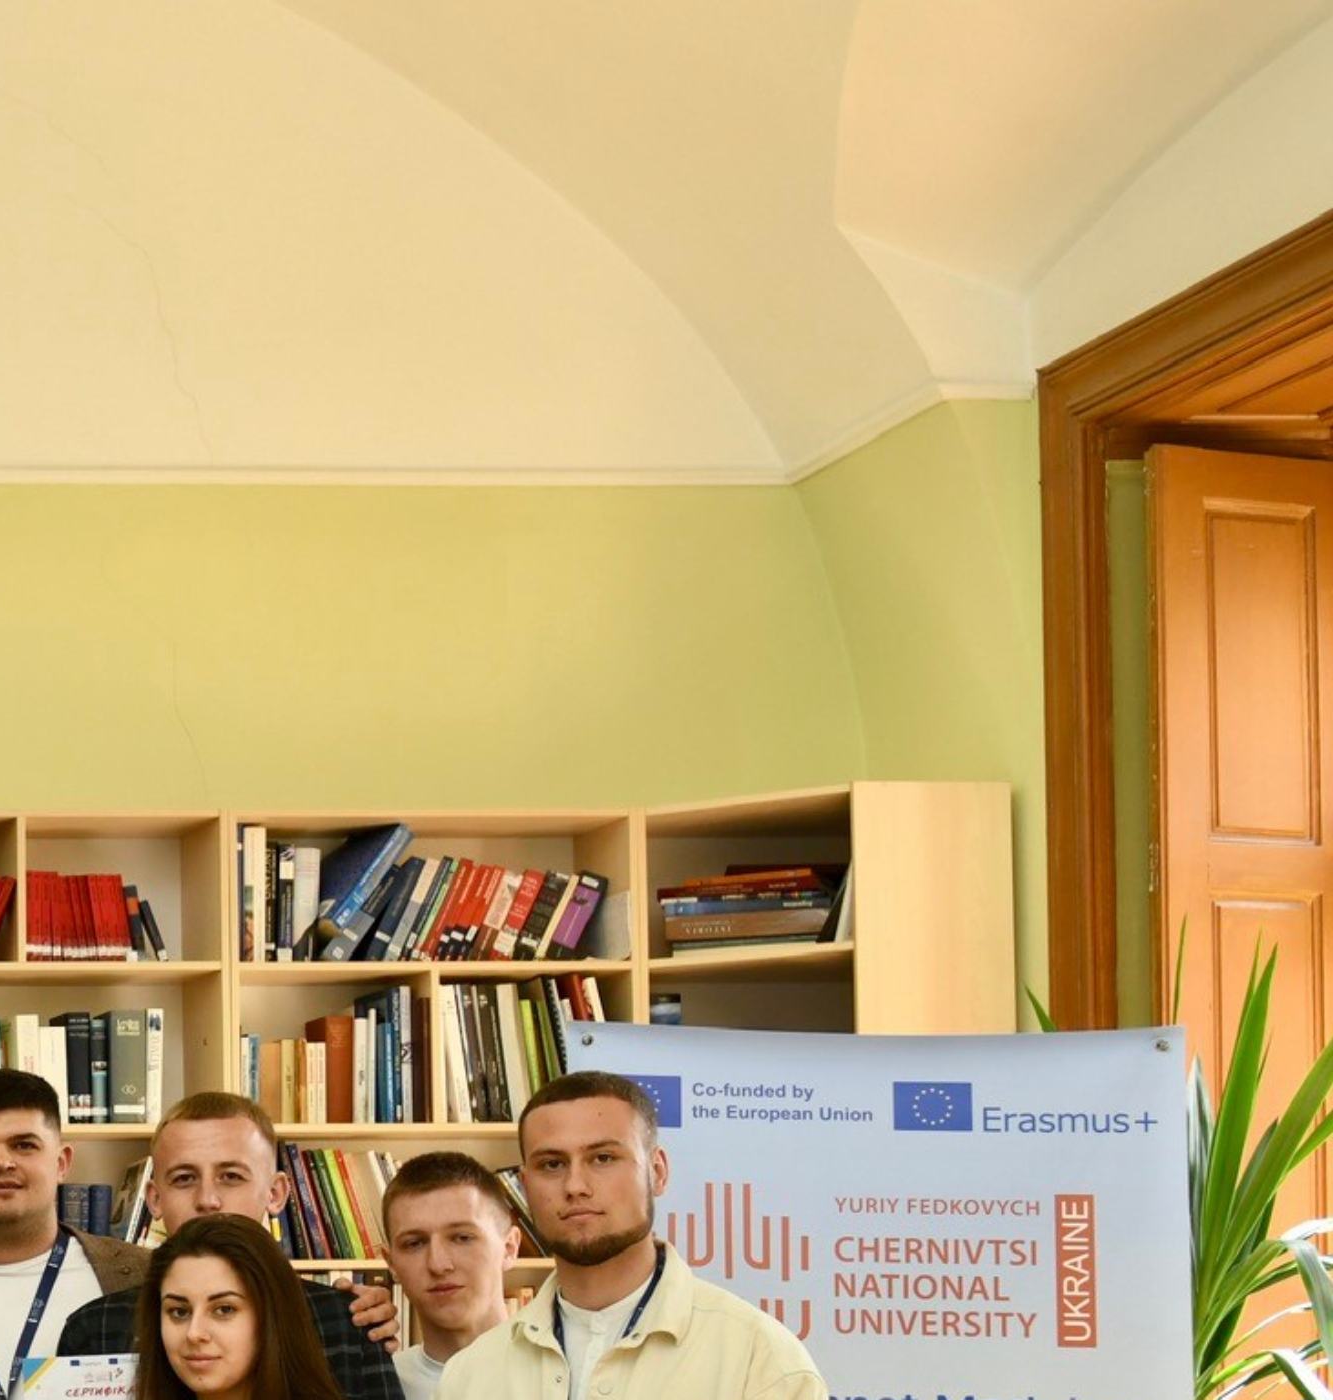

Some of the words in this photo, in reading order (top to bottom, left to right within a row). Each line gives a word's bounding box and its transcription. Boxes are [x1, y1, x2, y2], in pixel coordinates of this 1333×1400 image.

[692, 1082, 787, 1099] Co-funded
[792, 1084, 814, 1102] by
[691, 1105, 721, 1120] the
[725, 1105, 814, 1124] European
[818, 1107, 874, 1123] Union
[982, 1106, 1159, 1134] Erasmus+
[834, 1196, 900, 1214] YURIY
[907, 1198, 1041, 1217] FEDKOVYCH
[834, 1236, 1038, 1267] CHERNIVTSI
[1061, 1200, 1093, 1342] UKRAINE
[834, 1273, 1011, 1302] NATIONAL
[834, 1309, 1038, 1339] UNIVERSITY
